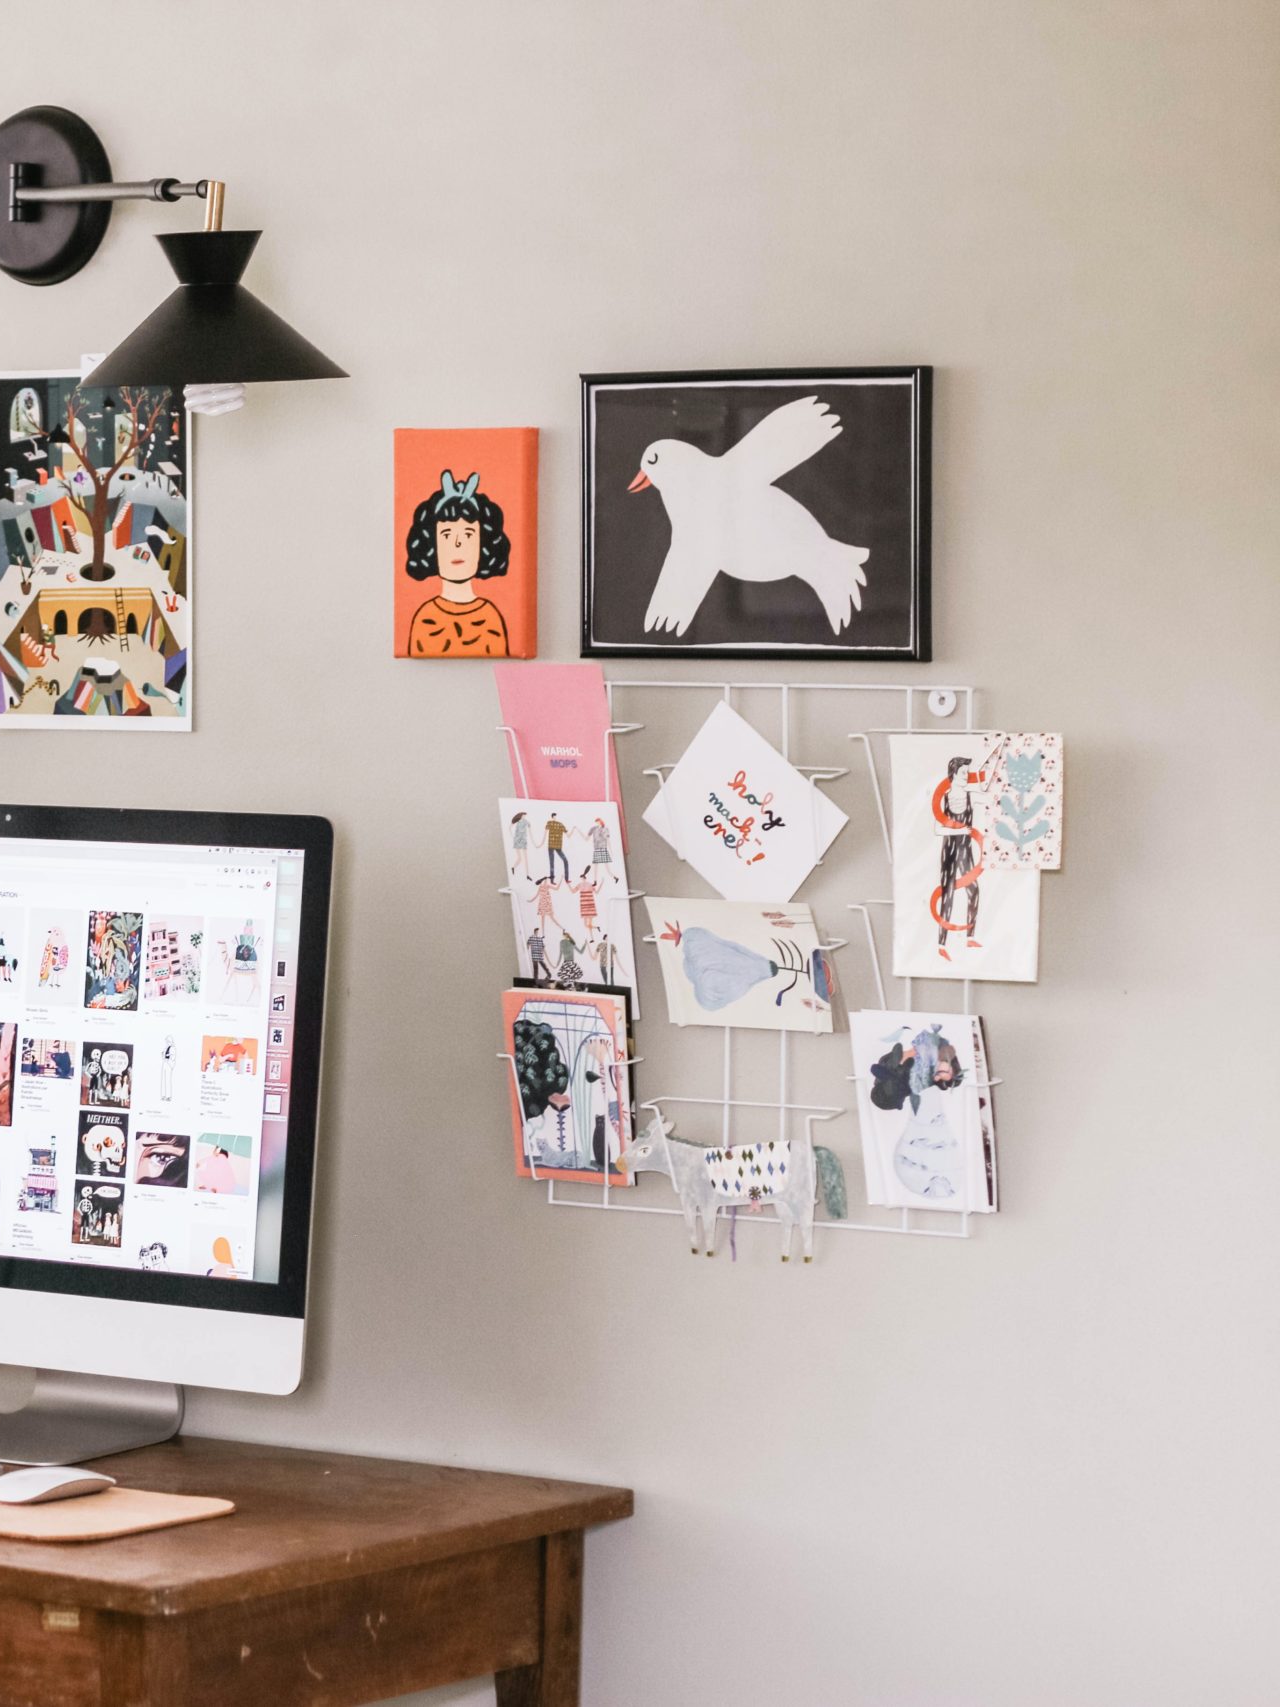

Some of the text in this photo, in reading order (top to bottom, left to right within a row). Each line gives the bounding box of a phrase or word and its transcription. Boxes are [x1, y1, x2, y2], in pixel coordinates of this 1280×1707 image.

[541, 746, 583, 757] WARHOL
[550, 759, 577, 768] MOPS
[728, 771, 785, 831] holy
[87, 1114, 122, 1125] NEITHER.
